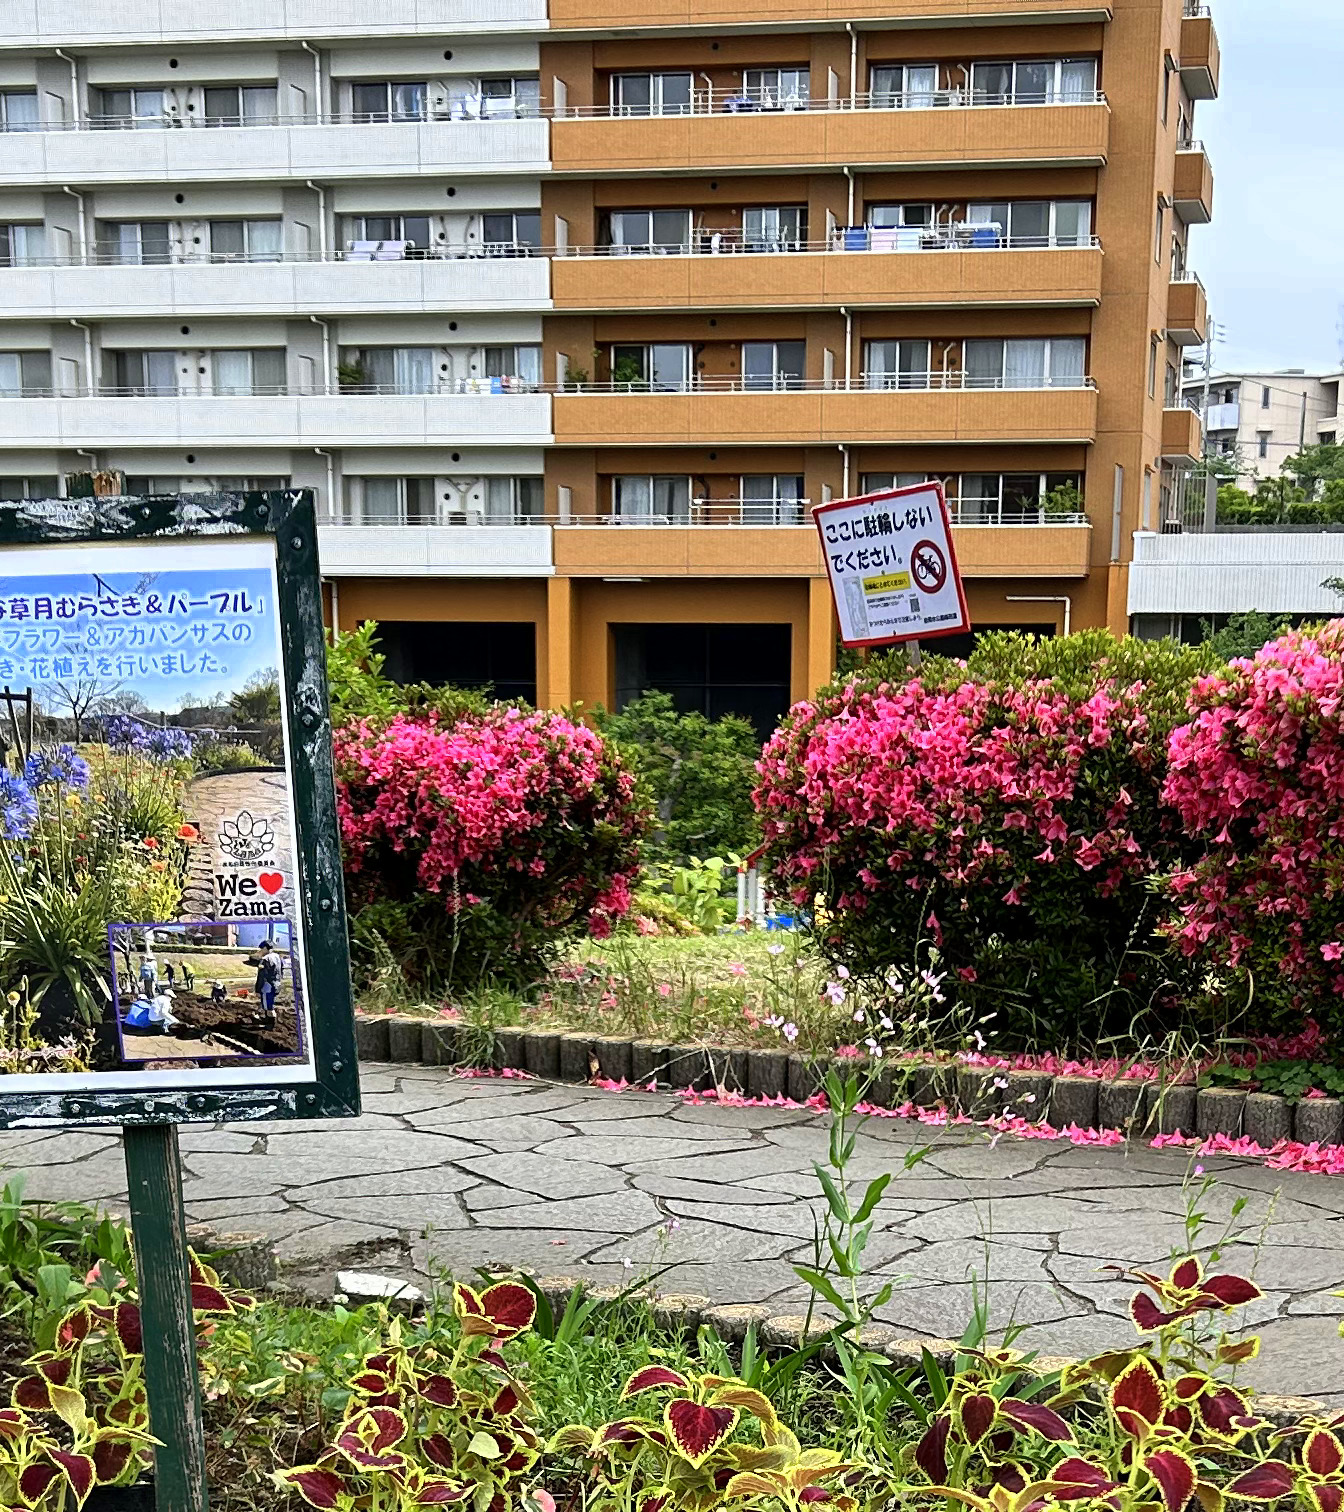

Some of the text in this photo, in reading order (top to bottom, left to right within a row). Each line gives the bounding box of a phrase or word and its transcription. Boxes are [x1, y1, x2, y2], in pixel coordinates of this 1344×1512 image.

[825, 505, 933, 544] ここに駐輪しない
[830, 544, 903, 574] でください。
[215, 873, 258, 897] We
[219, 898, 285, 917] Zama
